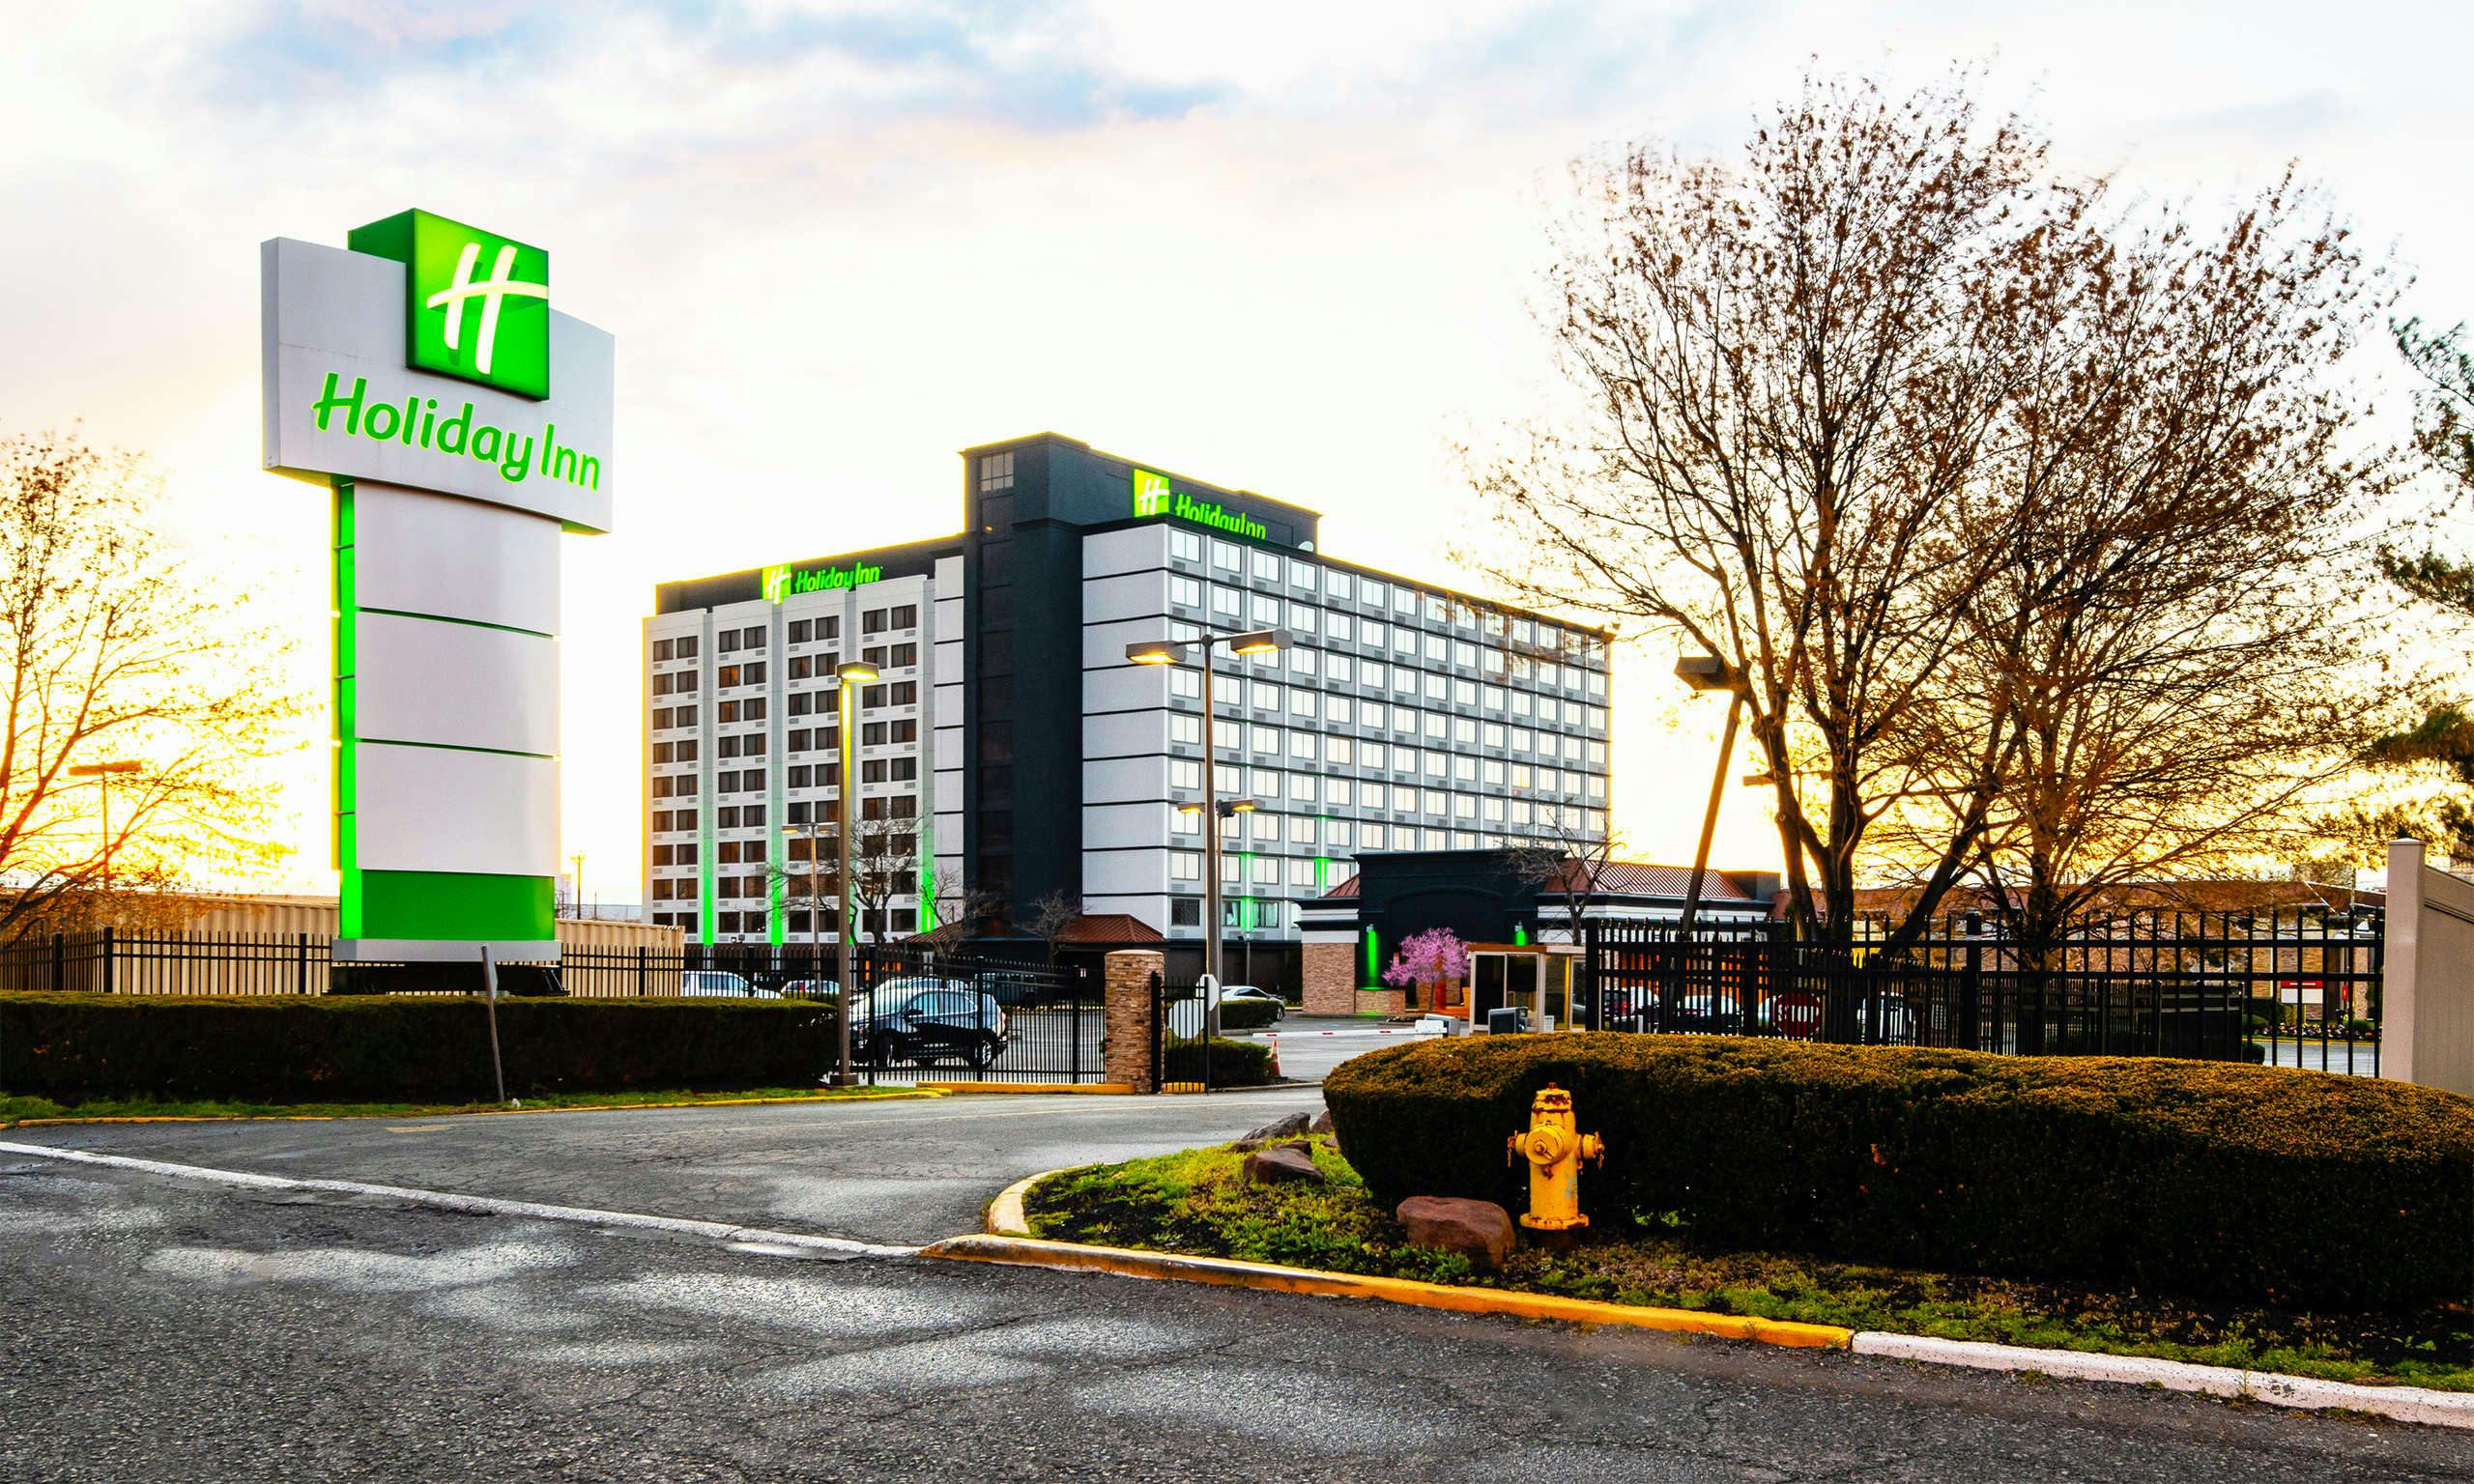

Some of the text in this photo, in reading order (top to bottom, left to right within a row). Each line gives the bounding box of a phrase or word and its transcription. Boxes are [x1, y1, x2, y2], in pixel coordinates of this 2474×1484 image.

[312, 373, 599, 490] Holiday Inn
[1240, 512, 1266, 539] Inn
[795, 561, 880, 592] Holiday Inn
